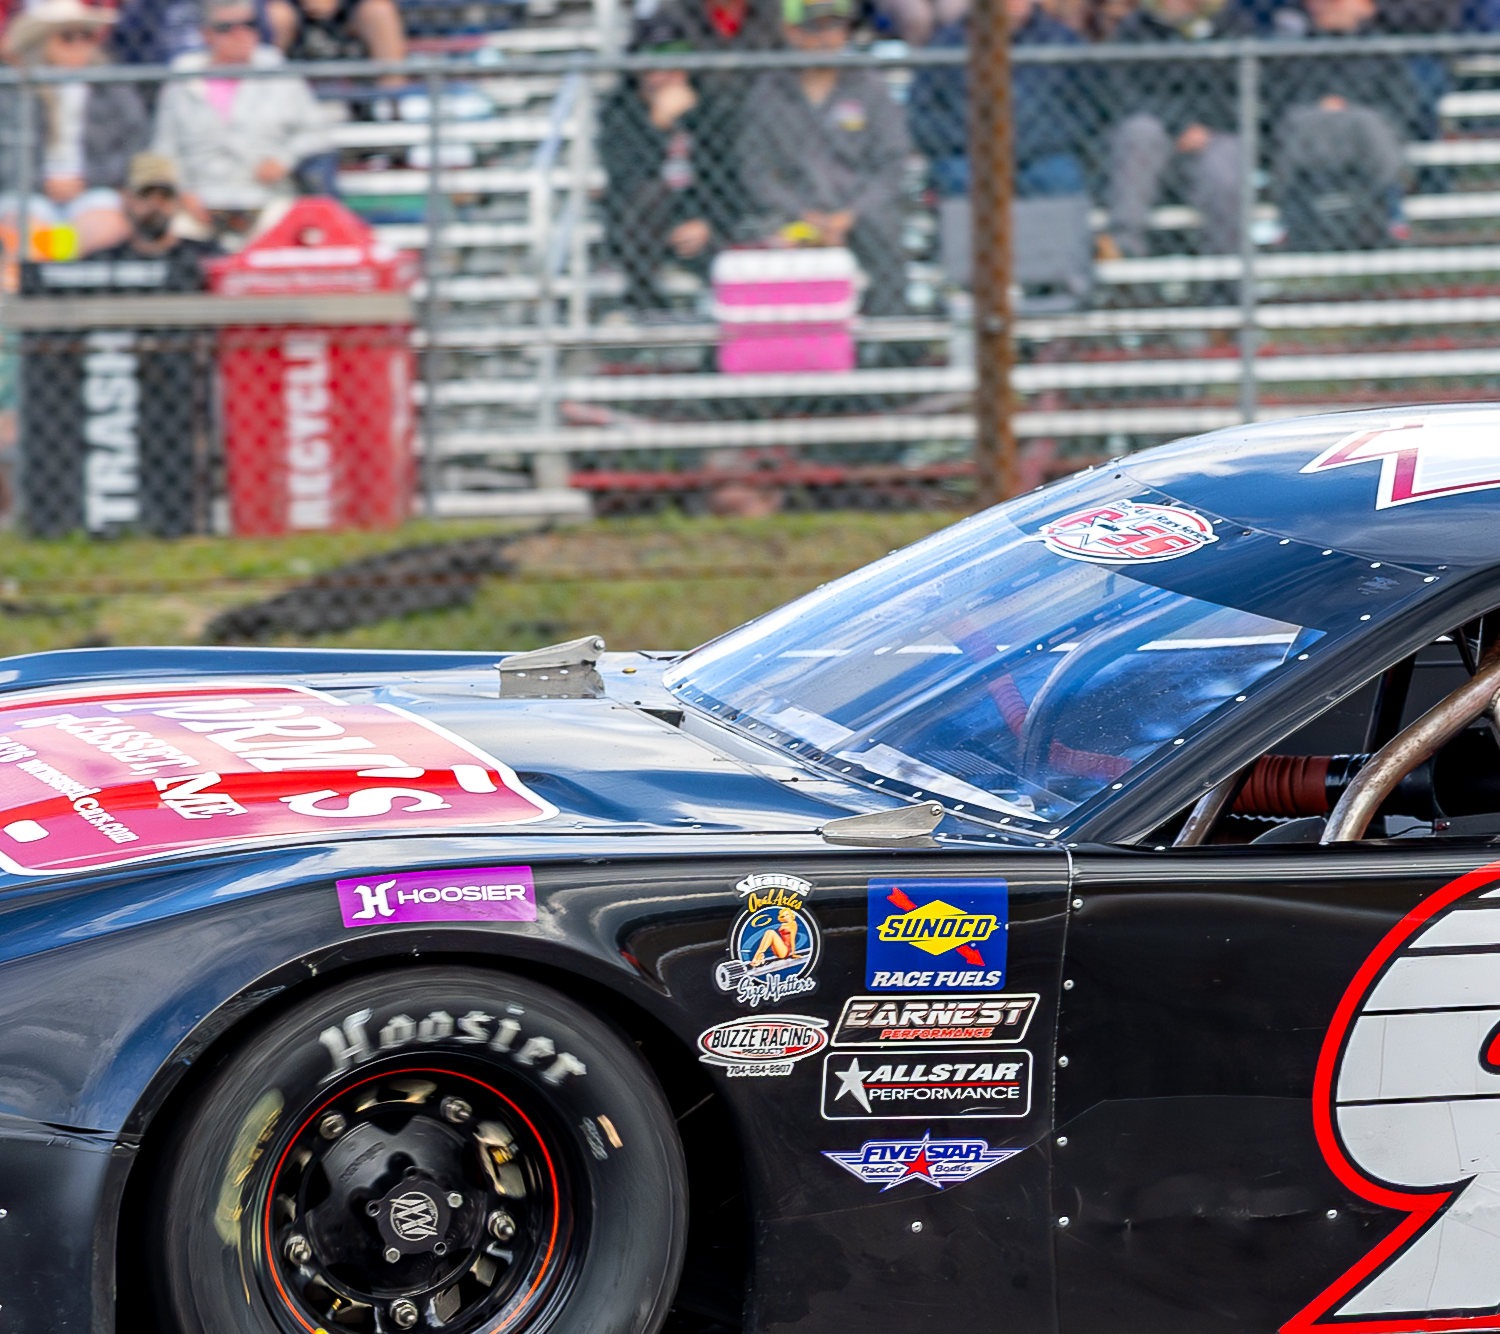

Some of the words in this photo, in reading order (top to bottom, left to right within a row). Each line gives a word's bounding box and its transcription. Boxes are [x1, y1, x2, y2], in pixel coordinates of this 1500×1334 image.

[152, 771, 249, 820] ME
[397, 884, 527, 904] HOOSIER
[735, 873, 814, 898] Strange
[773, 889, 803, 910] Axles
[884, 916, 990, 939] SUNOCO
[871, 972, 933, 987] RACE
[933, 970, 1003, 986] FUELS
[737, 976, 765, 1007] Size
[765, 974, 816, 1001] Matters
[843, 1000, 1033, 1028] EARNEST
[711, 1029, 759, 1048] BUZZE
[760, 1028, 814, 1047] RACING
[879, 1027, 996, 1040] PERFORMANCE
[318, 1003, 588, 1085] Hoosier
[866, 1063, 1020, 1082] ALLSTAR
[869, 1086, 1020, 1101] PERFORMANCE
[863, 1144, 921, 1163] FIVE
[927, 1144, 984, 1163] STAR
[935, 1164, 973, 1173] Bodies
